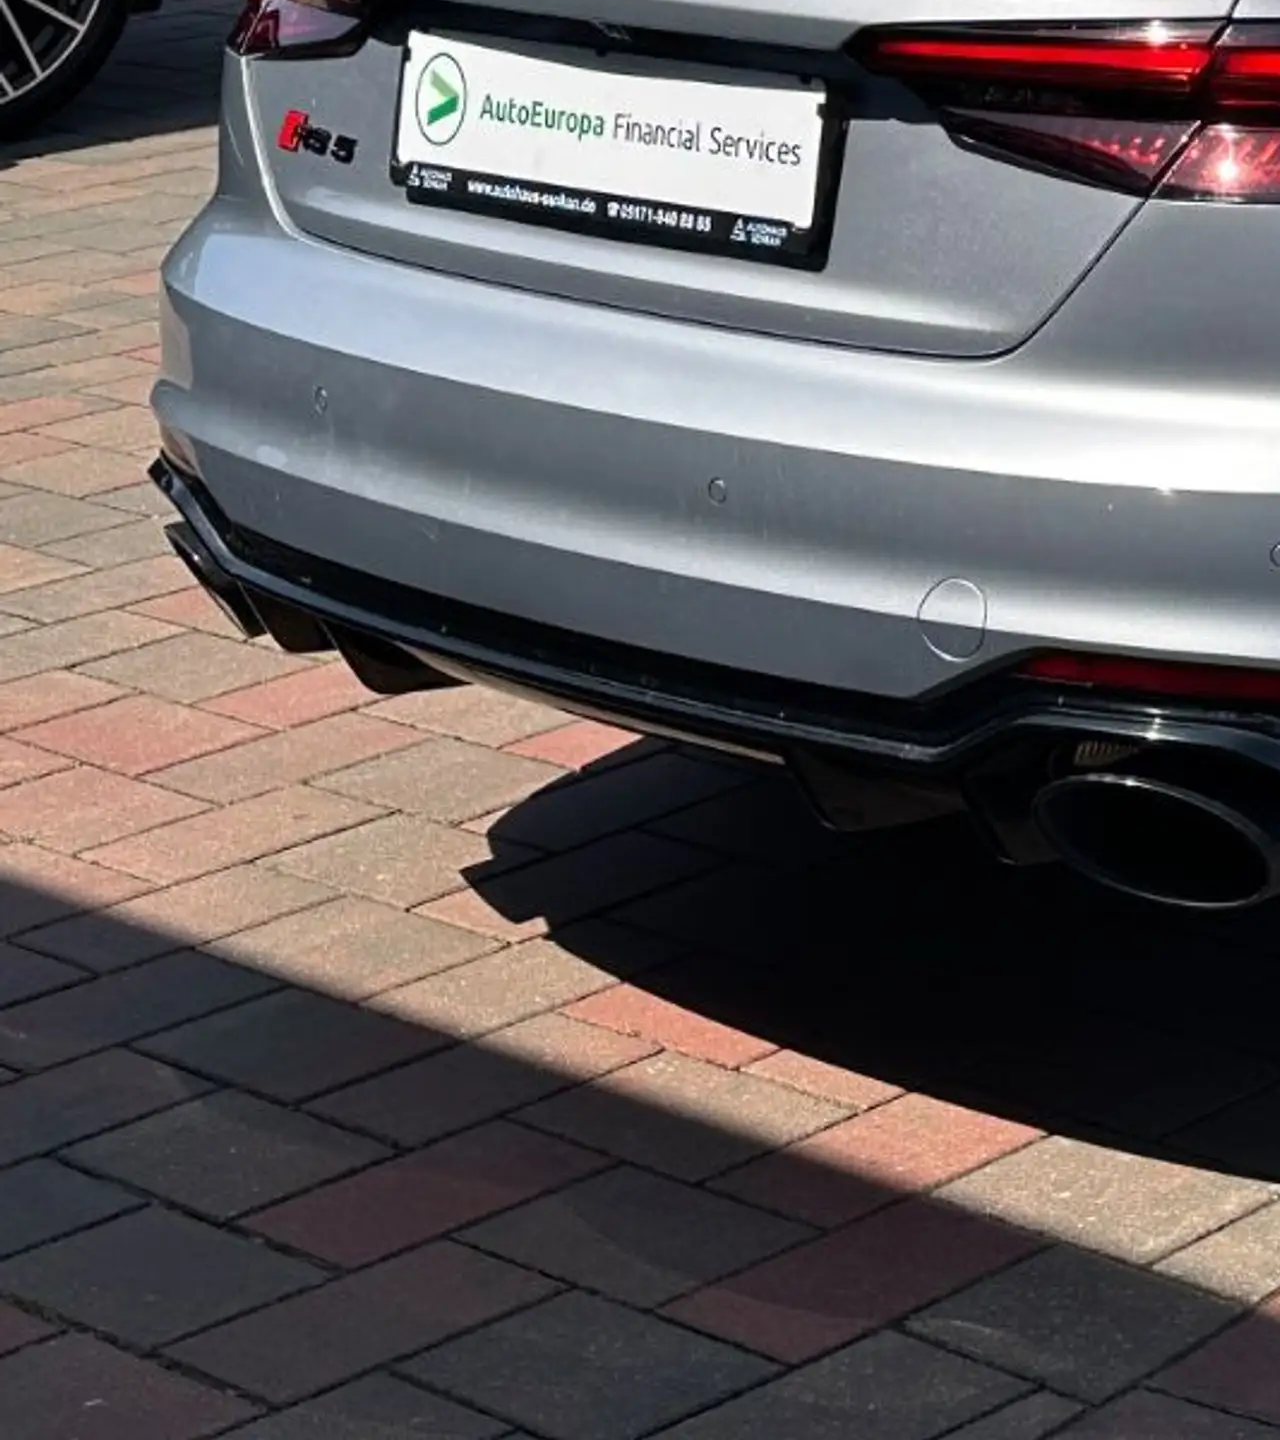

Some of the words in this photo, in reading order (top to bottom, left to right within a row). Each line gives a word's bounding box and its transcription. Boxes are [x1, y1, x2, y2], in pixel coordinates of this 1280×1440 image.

[479, 93, 606, 142] AutoEuropa
[612, 112, 701, 153] Financial
[708, 125, 803, 167] Services
